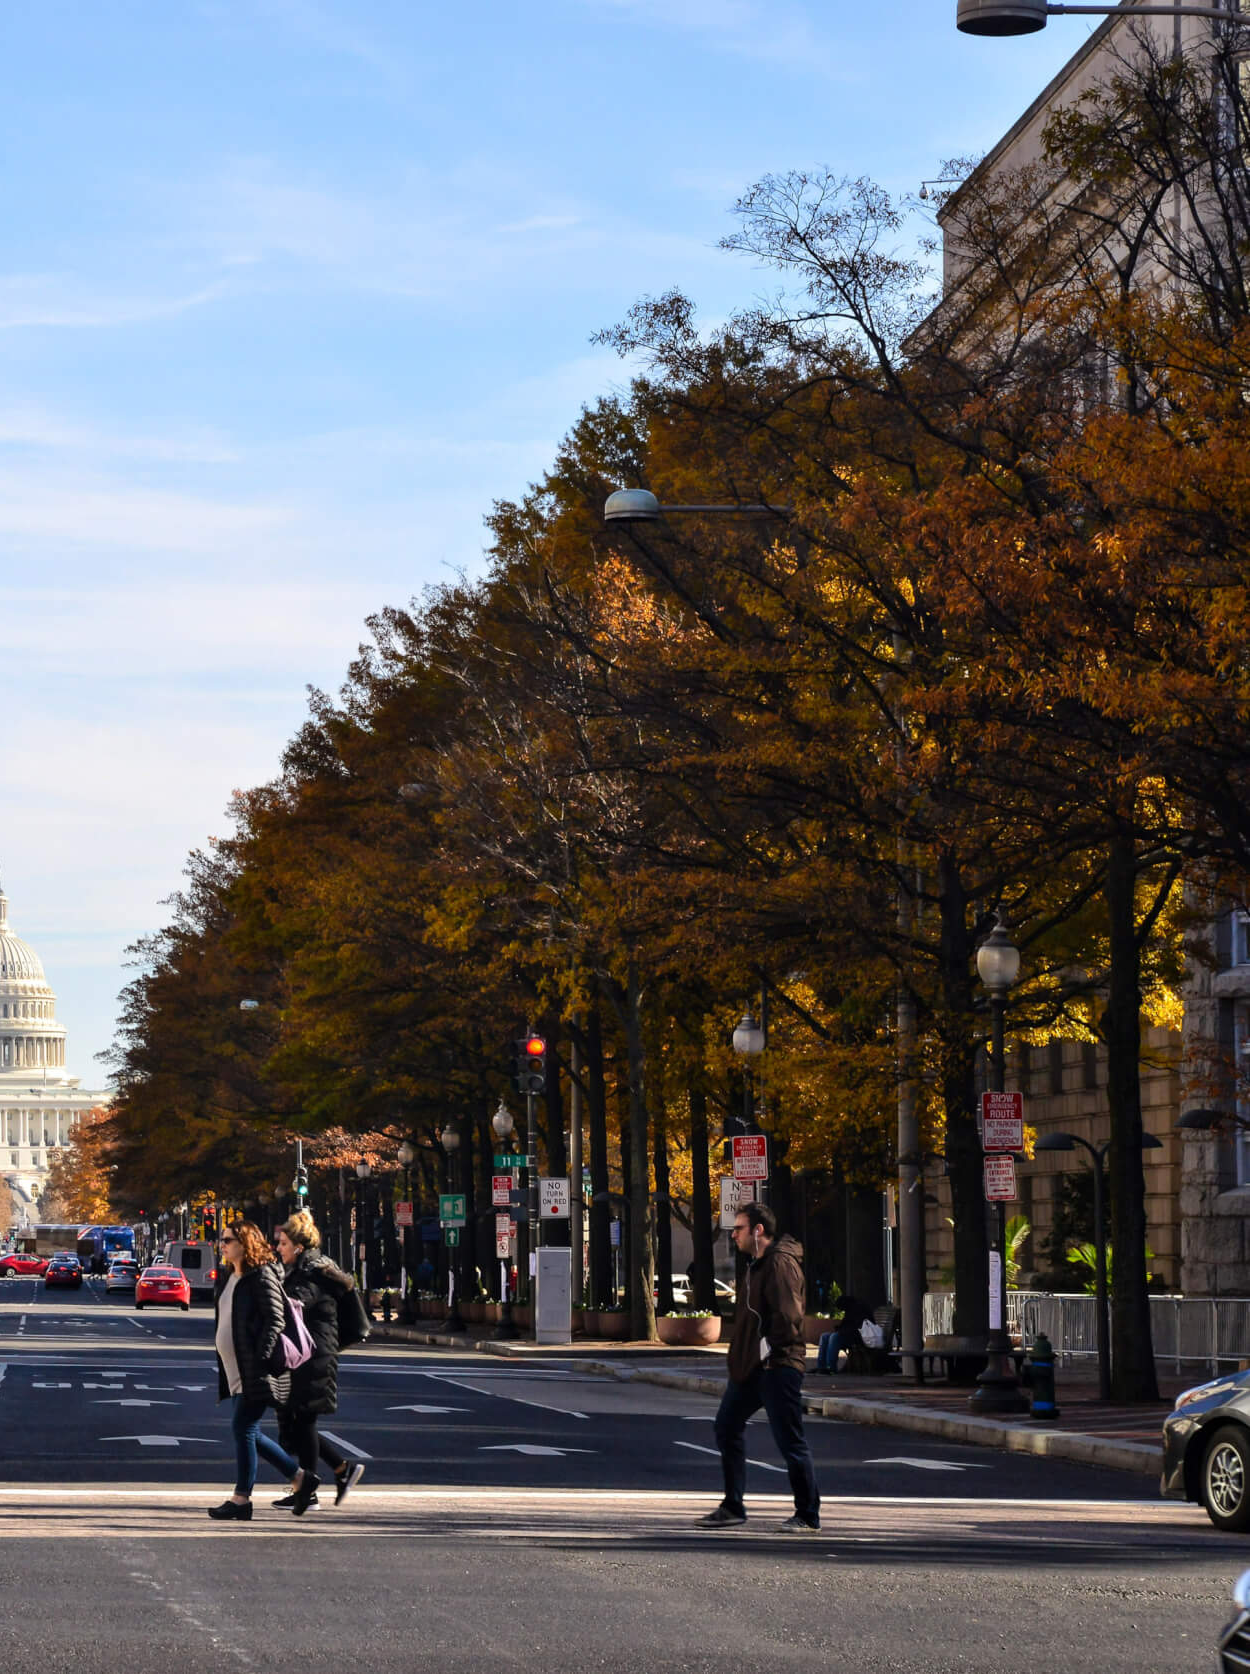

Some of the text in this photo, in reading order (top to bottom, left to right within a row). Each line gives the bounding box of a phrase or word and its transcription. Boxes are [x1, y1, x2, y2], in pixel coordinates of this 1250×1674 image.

[990, 1094, 1014, 1103] SNOW
[990, 1110, 1015, 1119] ROUTE
[502, 1157, 511, 1166] 11
[724, 1203, 736, 1212] ON
[32, 1382, 207, 1391] ONLY
